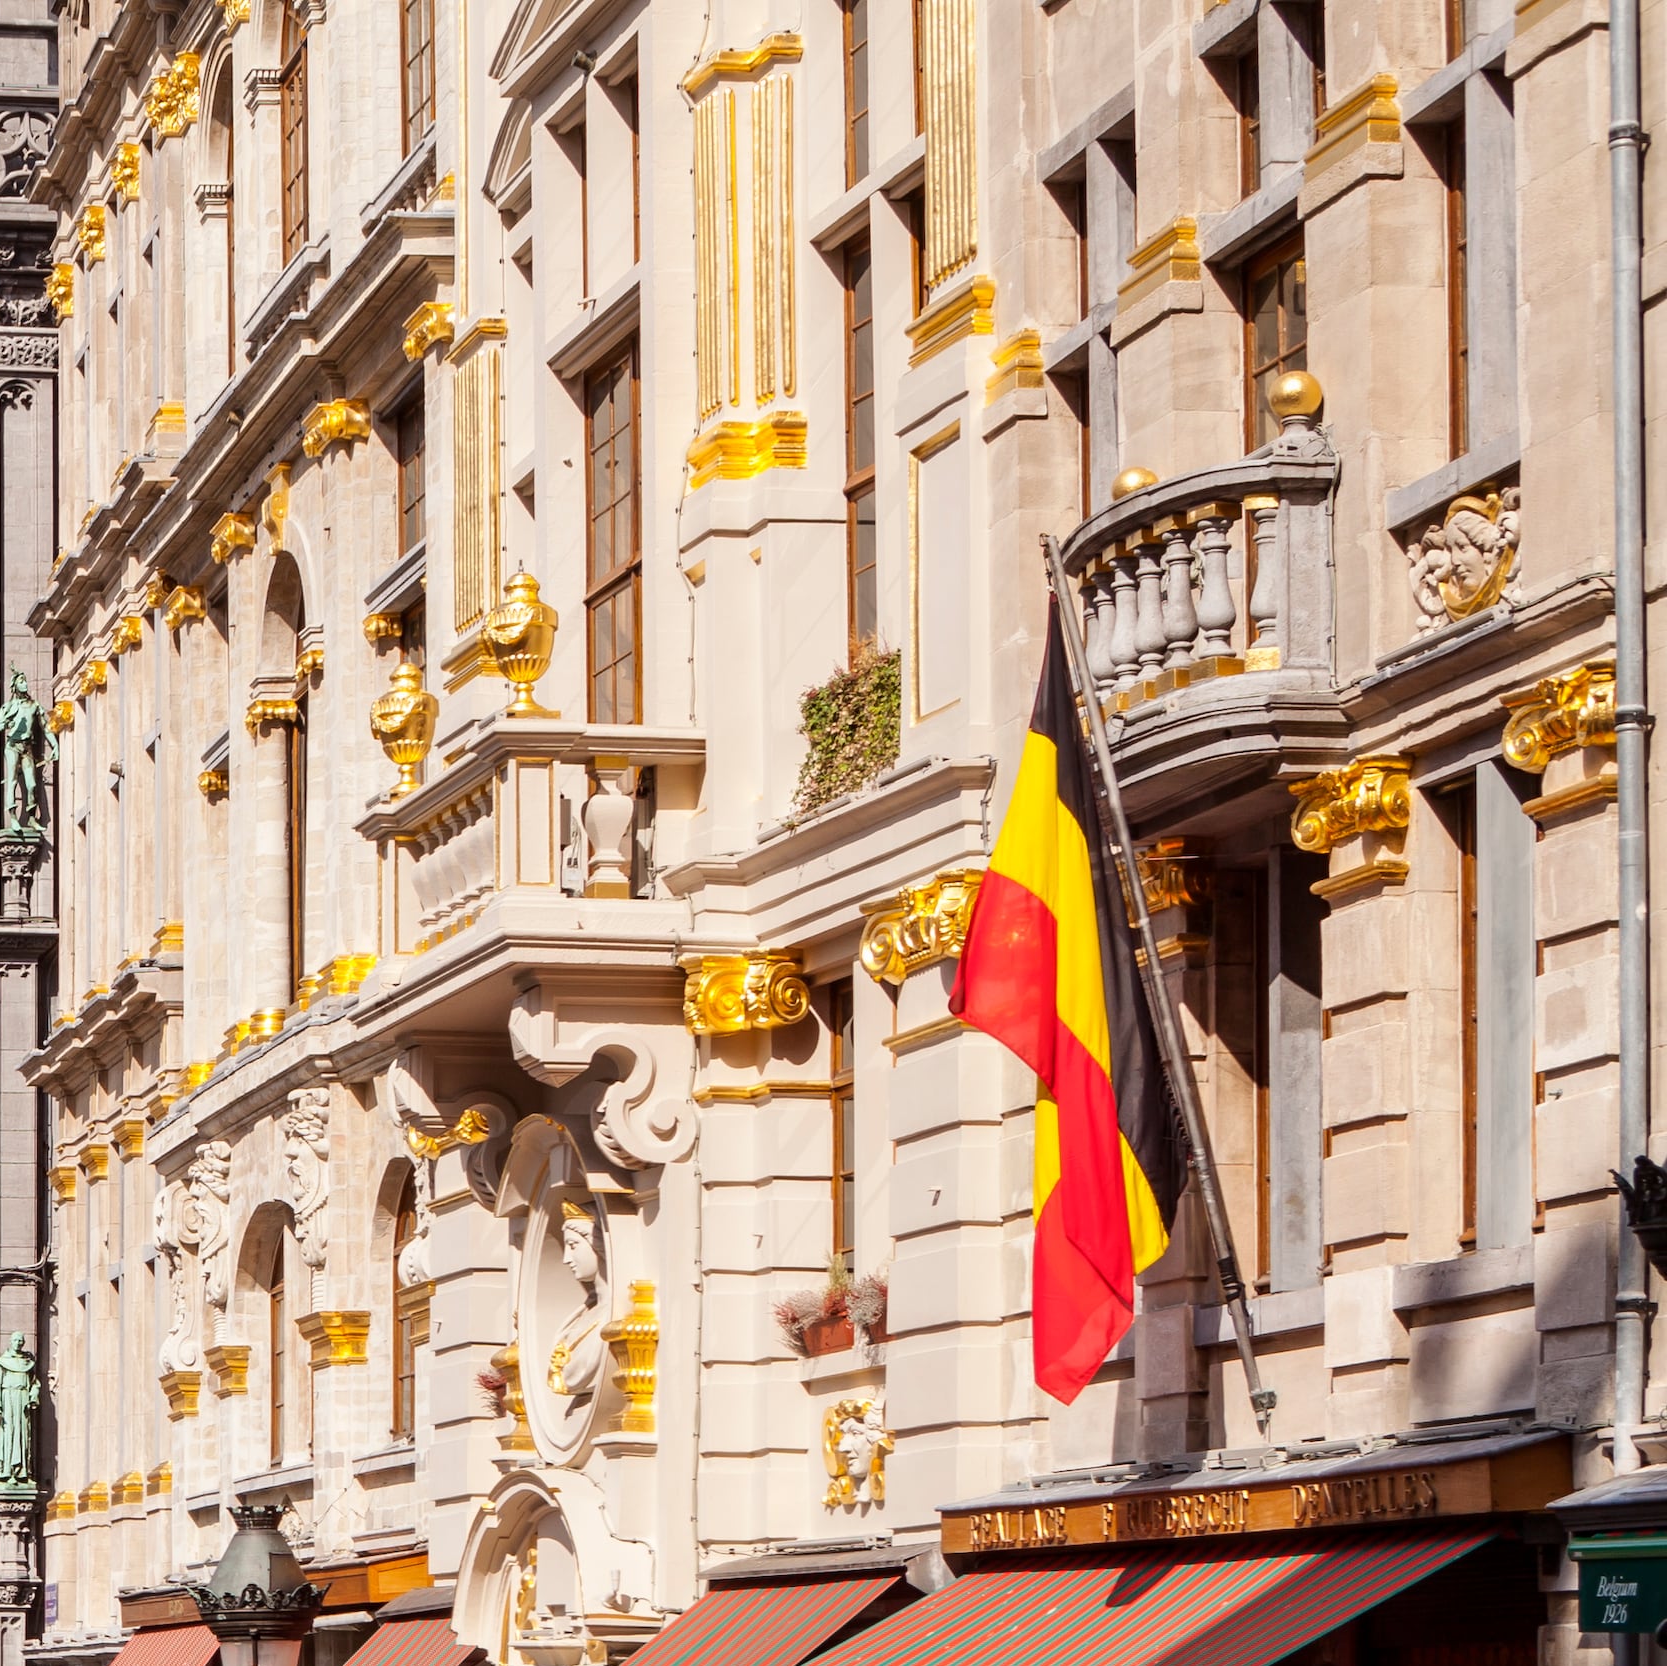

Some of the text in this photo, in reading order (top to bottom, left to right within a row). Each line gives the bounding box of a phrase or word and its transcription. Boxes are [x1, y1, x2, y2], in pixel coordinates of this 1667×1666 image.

[1126, 1489, 1250, 1534] RUBBRECHT
[1291, 1472, 1437, 1523] DENTELLES
[1596, 1575, 1638, 1602] Belgium
[1601, 1603, 1628, 1624] 1926
